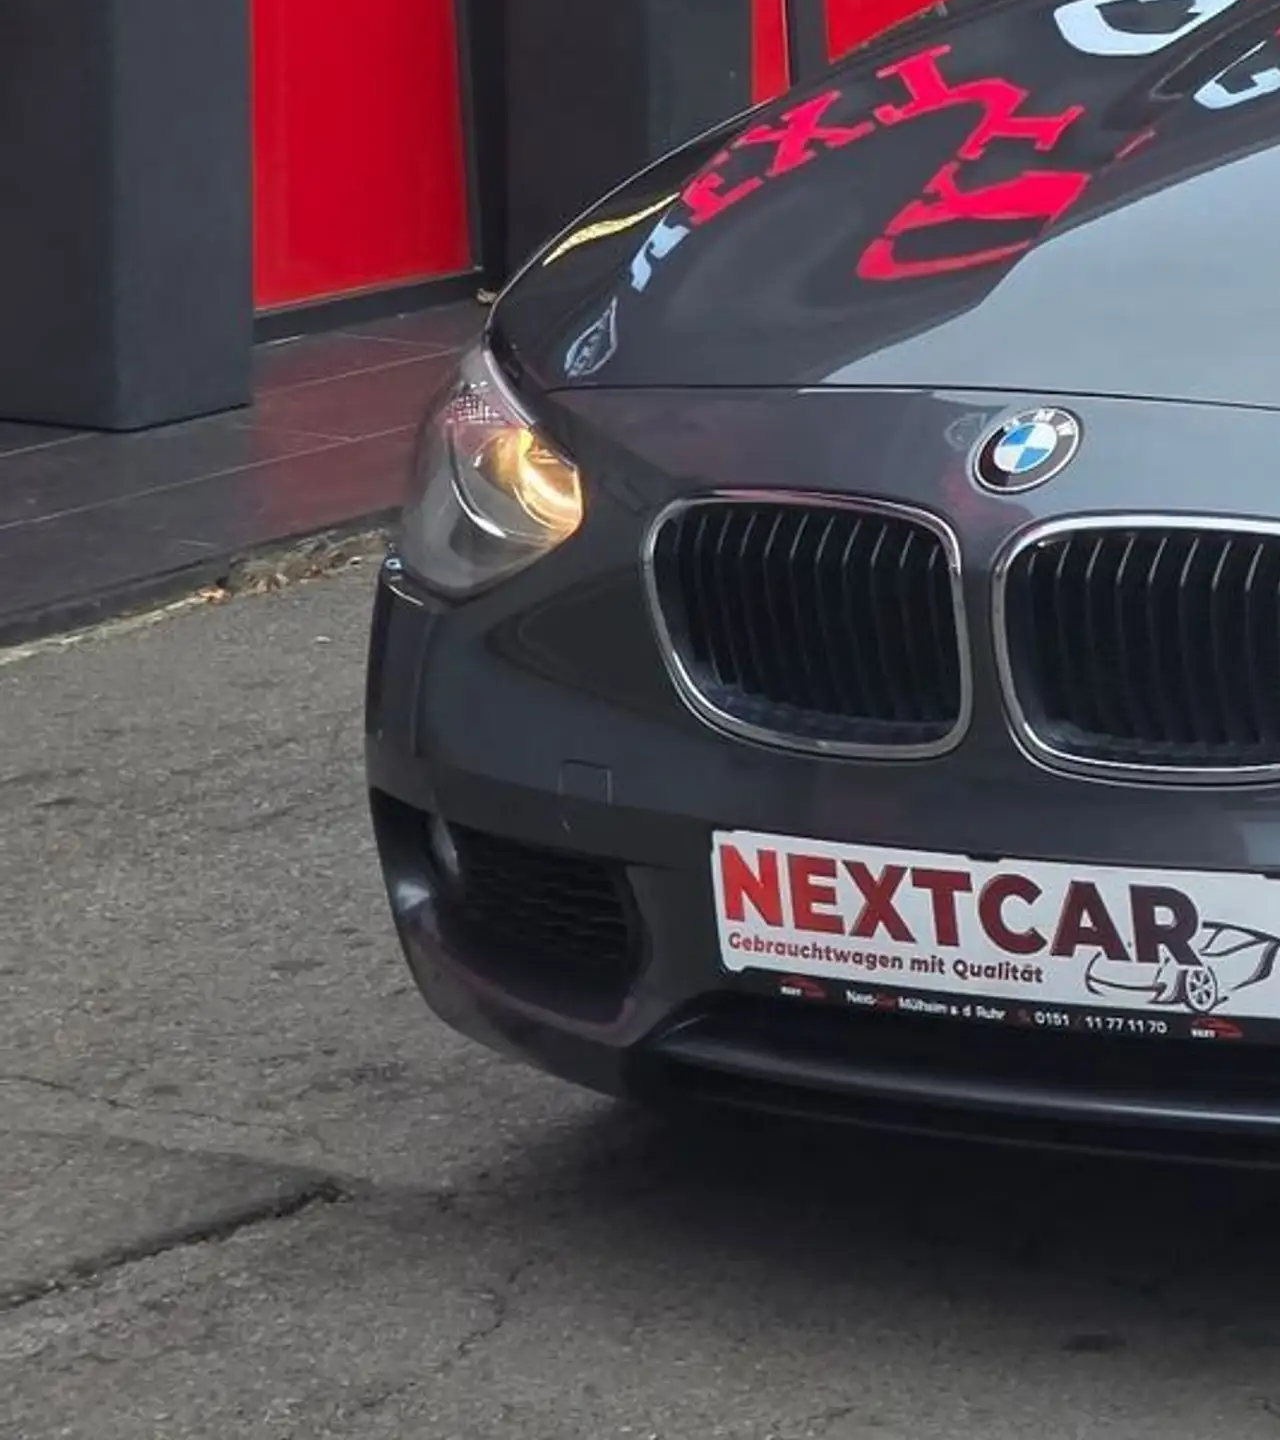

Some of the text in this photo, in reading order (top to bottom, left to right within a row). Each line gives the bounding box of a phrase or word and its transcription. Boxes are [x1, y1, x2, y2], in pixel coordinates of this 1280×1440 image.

[719, 843, 1204, 966] NEXTCAR
[727, 931, 1044, 984] Gebrauchtwagen mit Qualität
